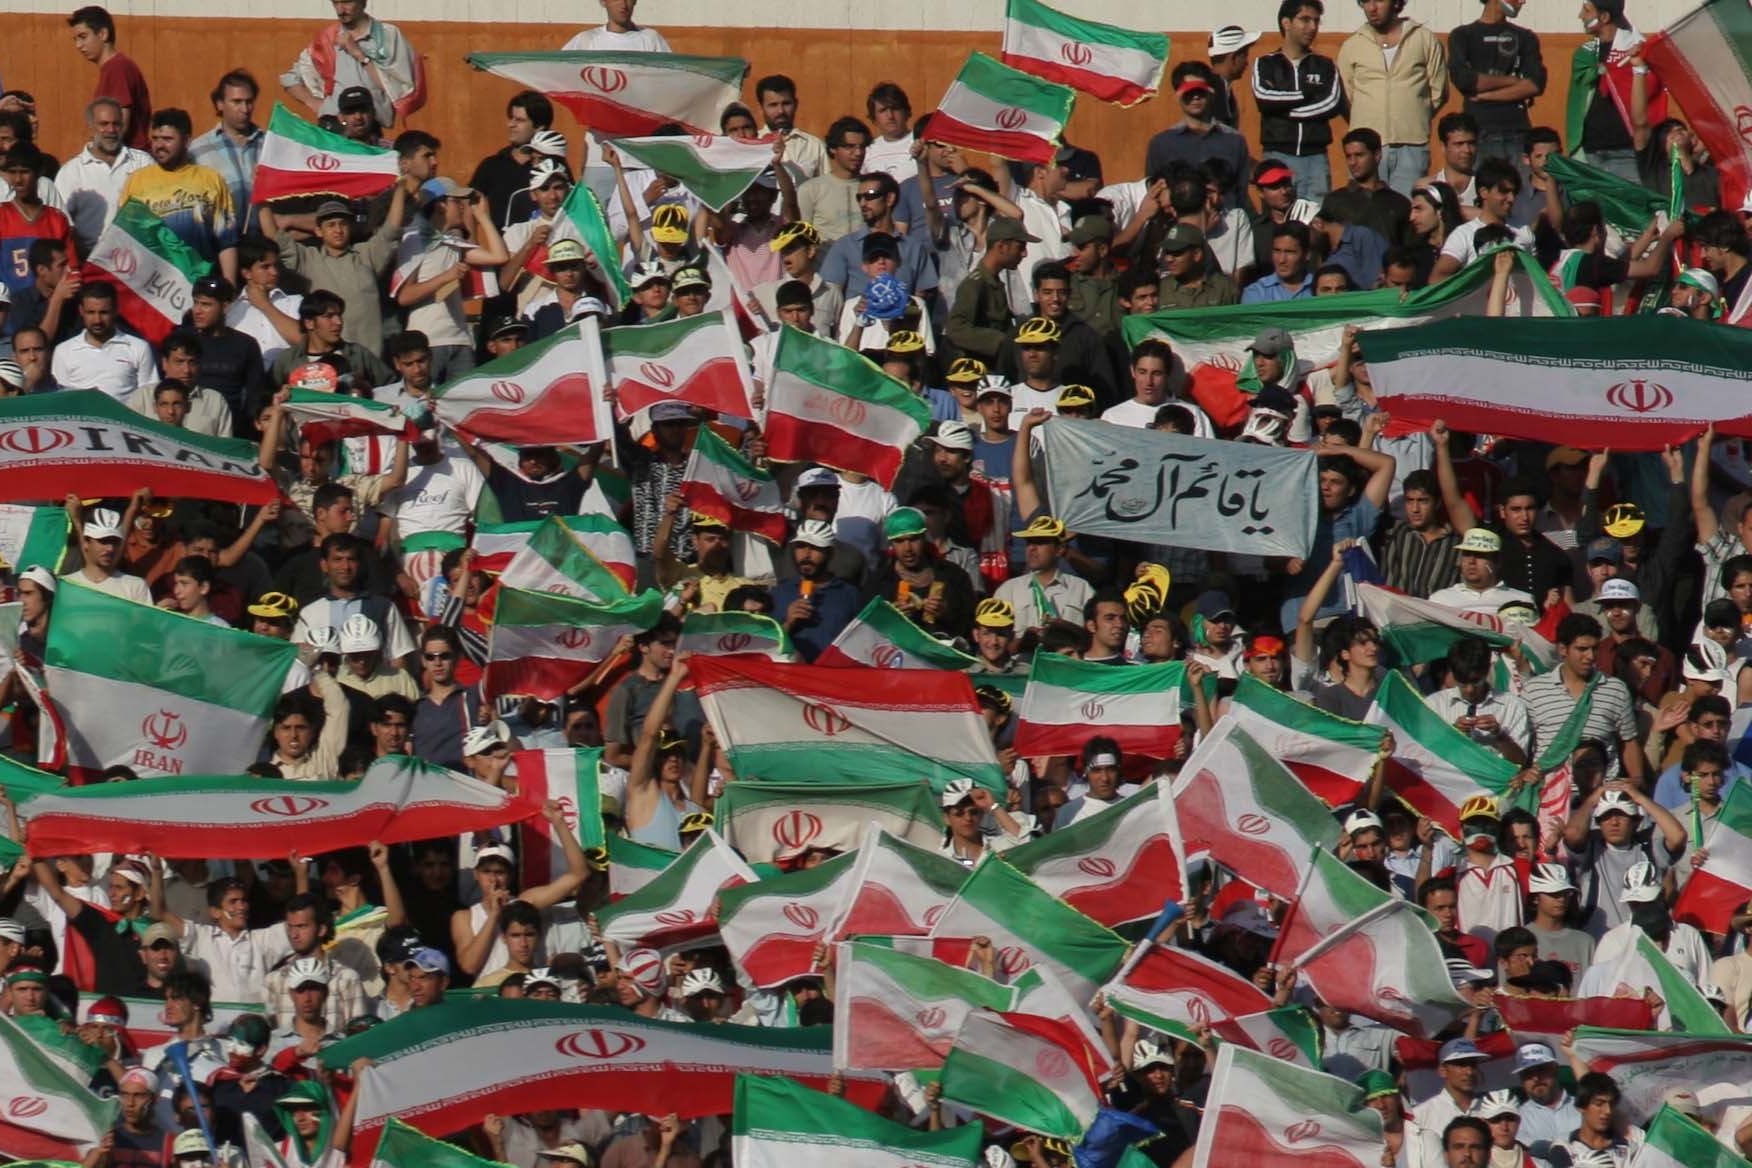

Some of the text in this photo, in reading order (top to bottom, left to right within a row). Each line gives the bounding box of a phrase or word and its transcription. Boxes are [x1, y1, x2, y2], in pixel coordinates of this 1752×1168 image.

[11, 247, 29, 278] 5
[79, 425, 261, 478] IRAN
[134, 748, 185, 775] IRAN
